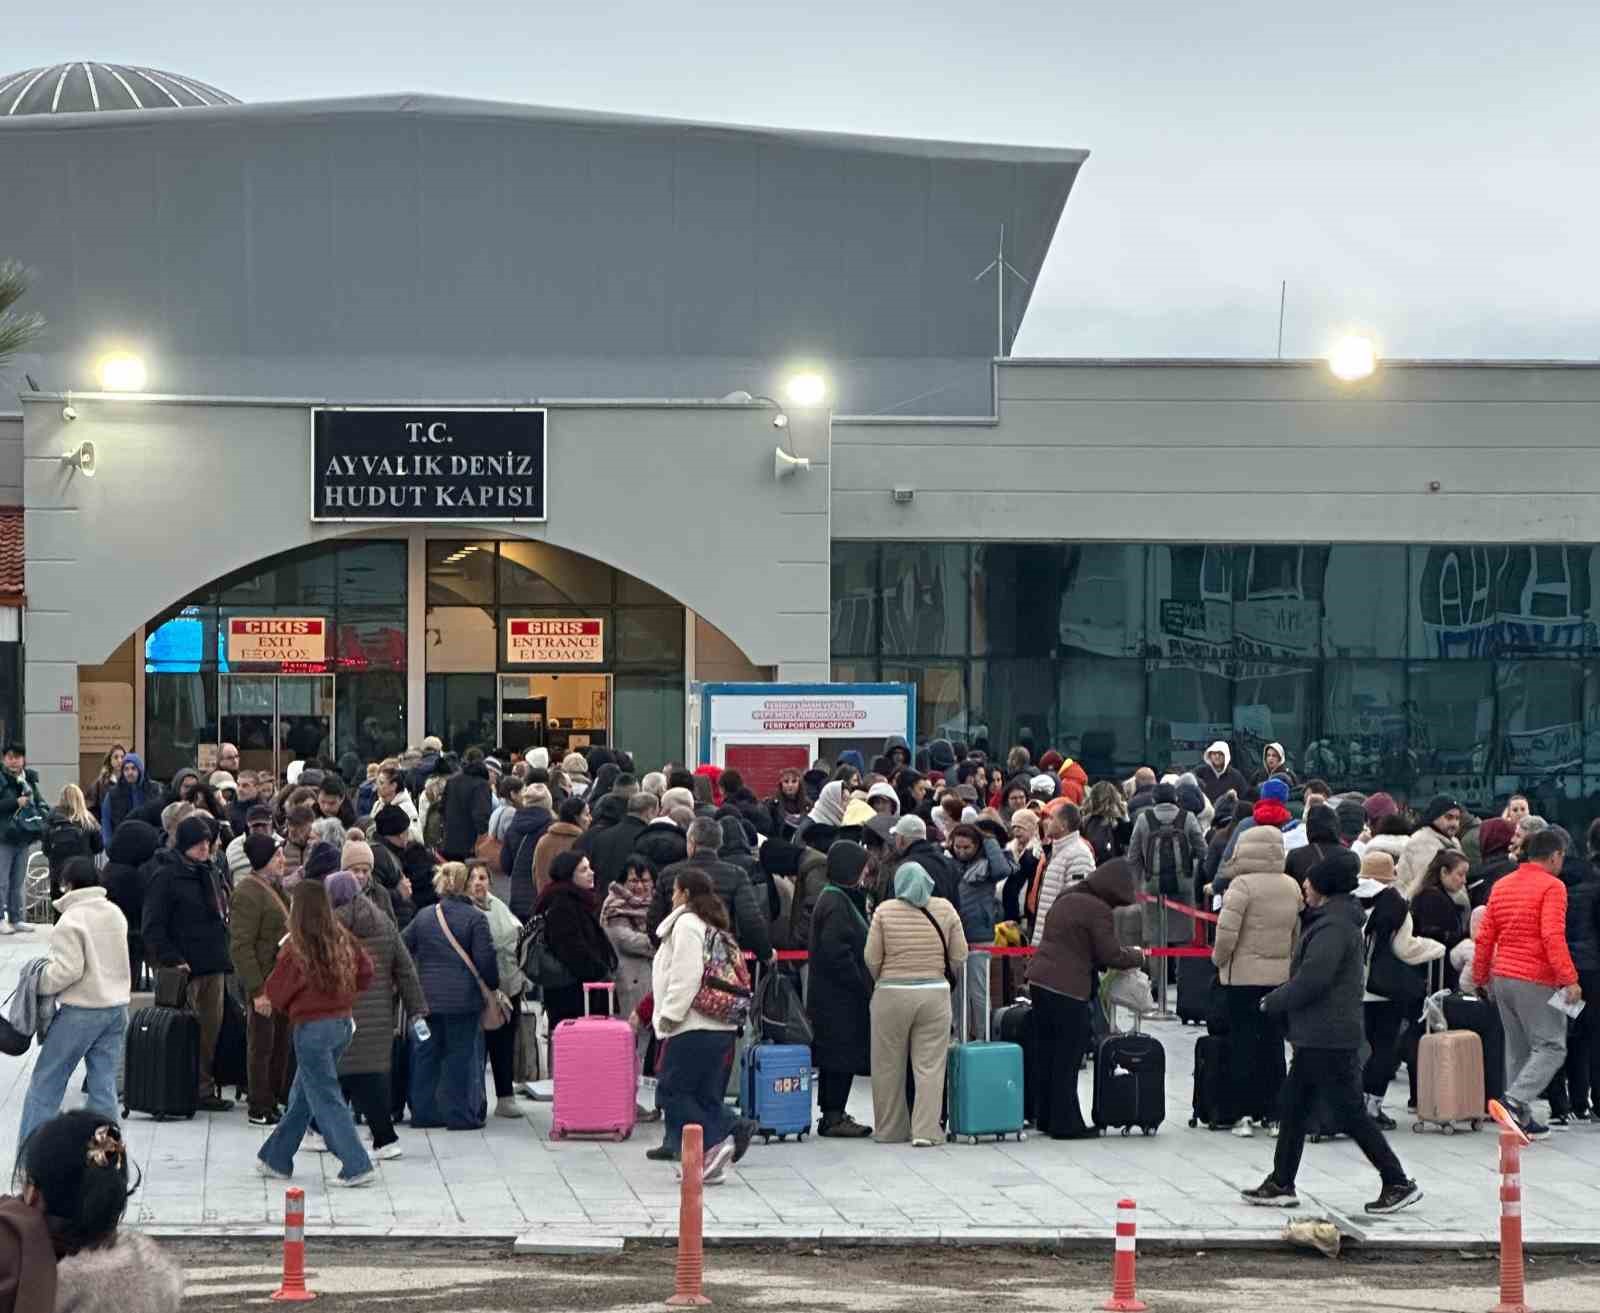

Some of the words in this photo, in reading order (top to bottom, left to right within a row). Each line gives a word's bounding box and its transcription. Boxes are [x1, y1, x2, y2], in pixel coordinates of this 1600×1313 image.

[405, 422, 453, 443] T.C.
[326, 456, 443, 476] AYVALIK
[451, 451, 533, 476] DENİZ
[324, 486, 427, 507] HUDUT
[435, 486, 534, 507] KAPISI
[258, 636, 295, 648] EXIT
[512, 637, 599, 648] ENTRANCE
[827, 721, 852, 729] OFFICE
